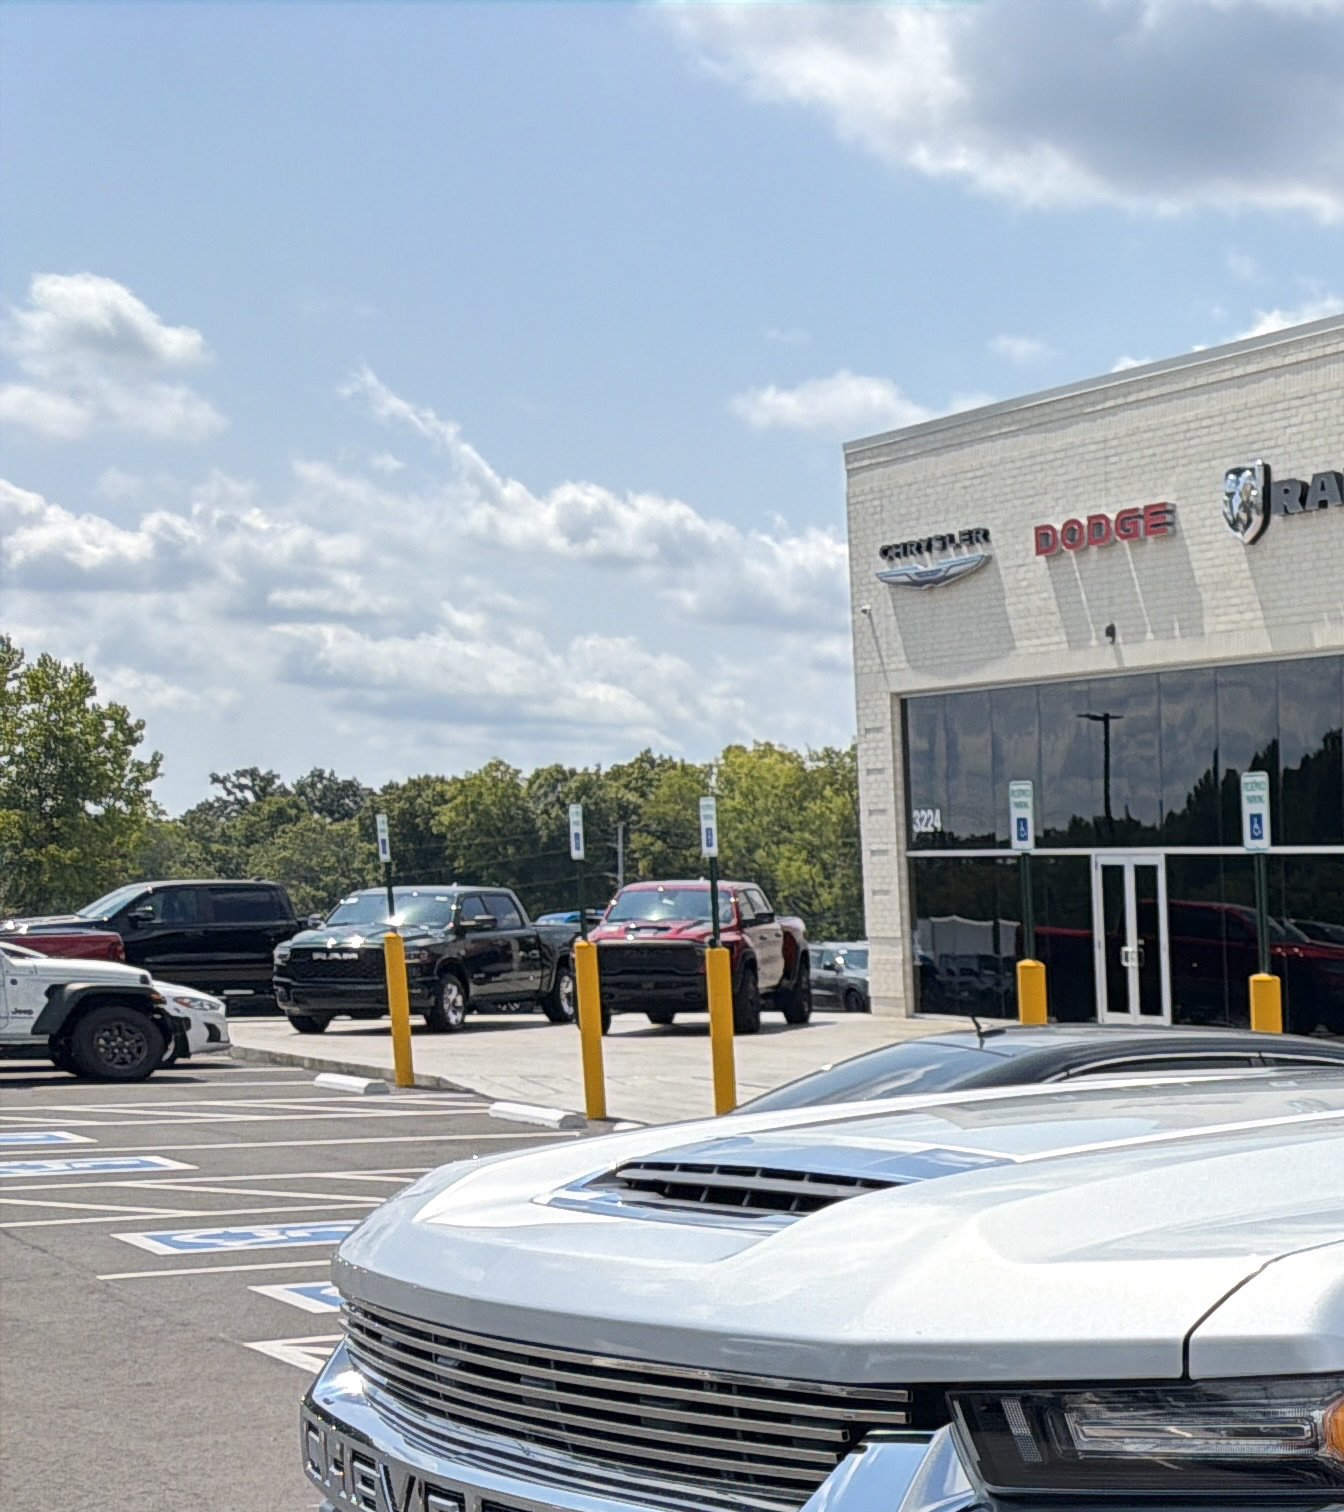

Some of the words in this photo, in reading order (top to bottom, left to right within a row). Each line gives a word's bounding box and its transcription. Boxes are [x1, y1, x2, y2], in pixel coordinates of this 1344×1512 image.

[879, 527, 991, 561] CHRYSLER
[1034, 502, 1176, 557] DODGE
[912, 808, 942, 833] 3224
